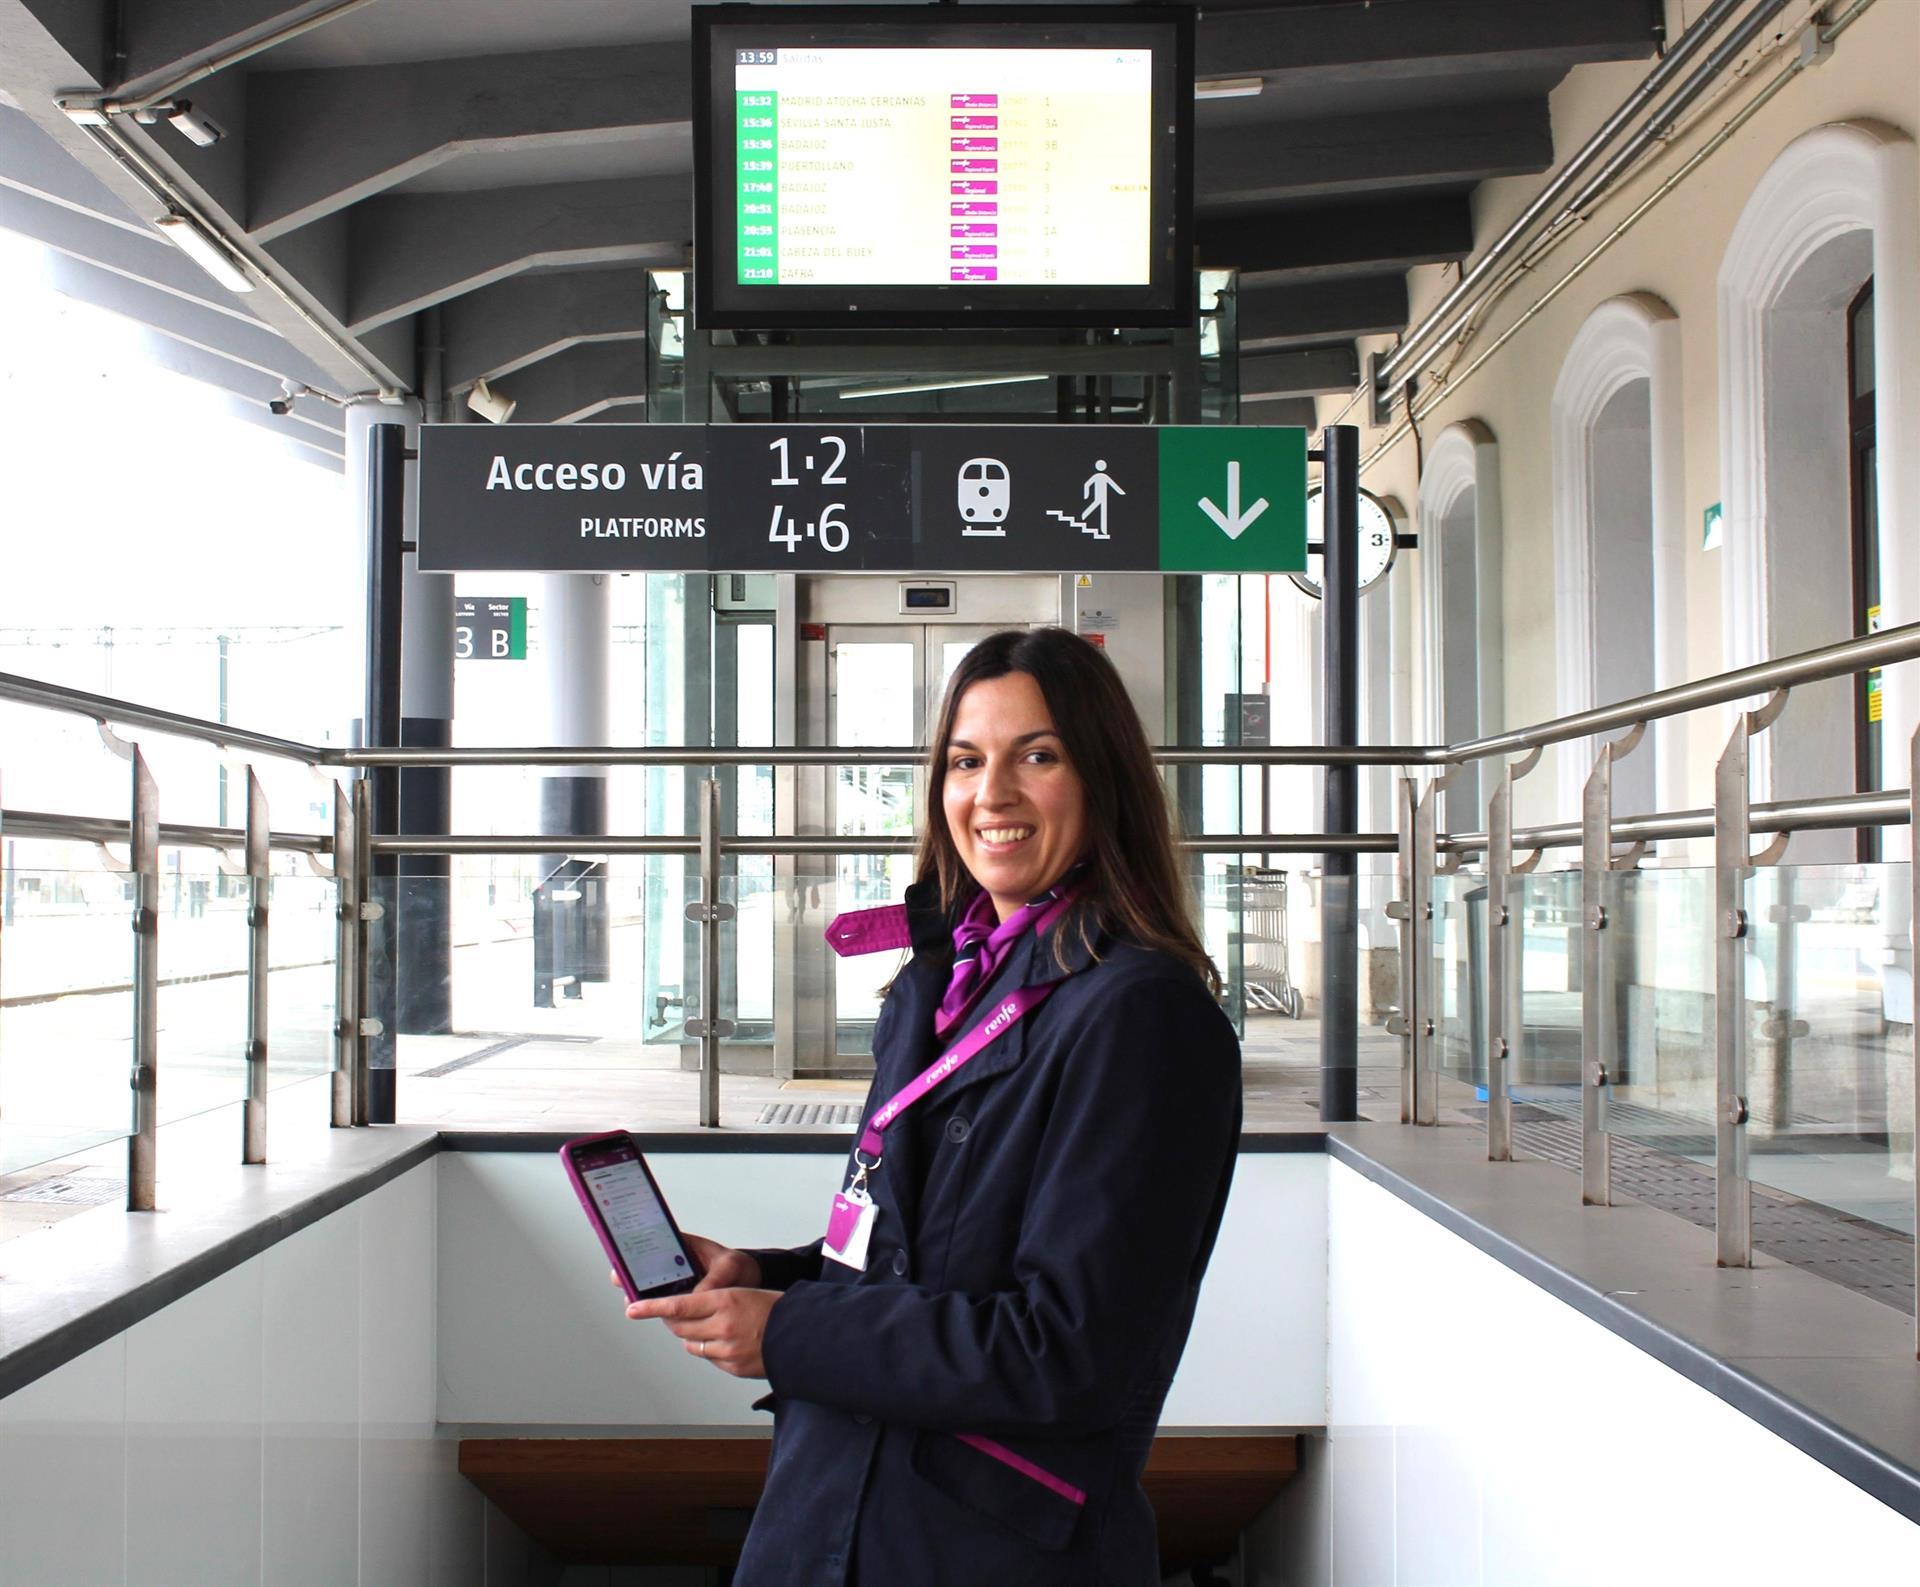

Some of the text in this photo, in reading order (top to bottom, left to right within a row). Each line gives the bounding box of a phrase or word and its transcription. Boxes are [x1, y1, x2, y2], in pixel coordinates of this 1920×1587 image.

[486, 452, 702, 490] Acceso vía
[581, 518, 705, 537] PLATFORMS
[1372, 534, 1383, 546] 3
[456, 626, 508, 658] 3 B
[984, 1002, 1017, 1036] renfe
[925, 1053, 959, 1084] renfe
[873, 1101, 899, 1128] enfe
